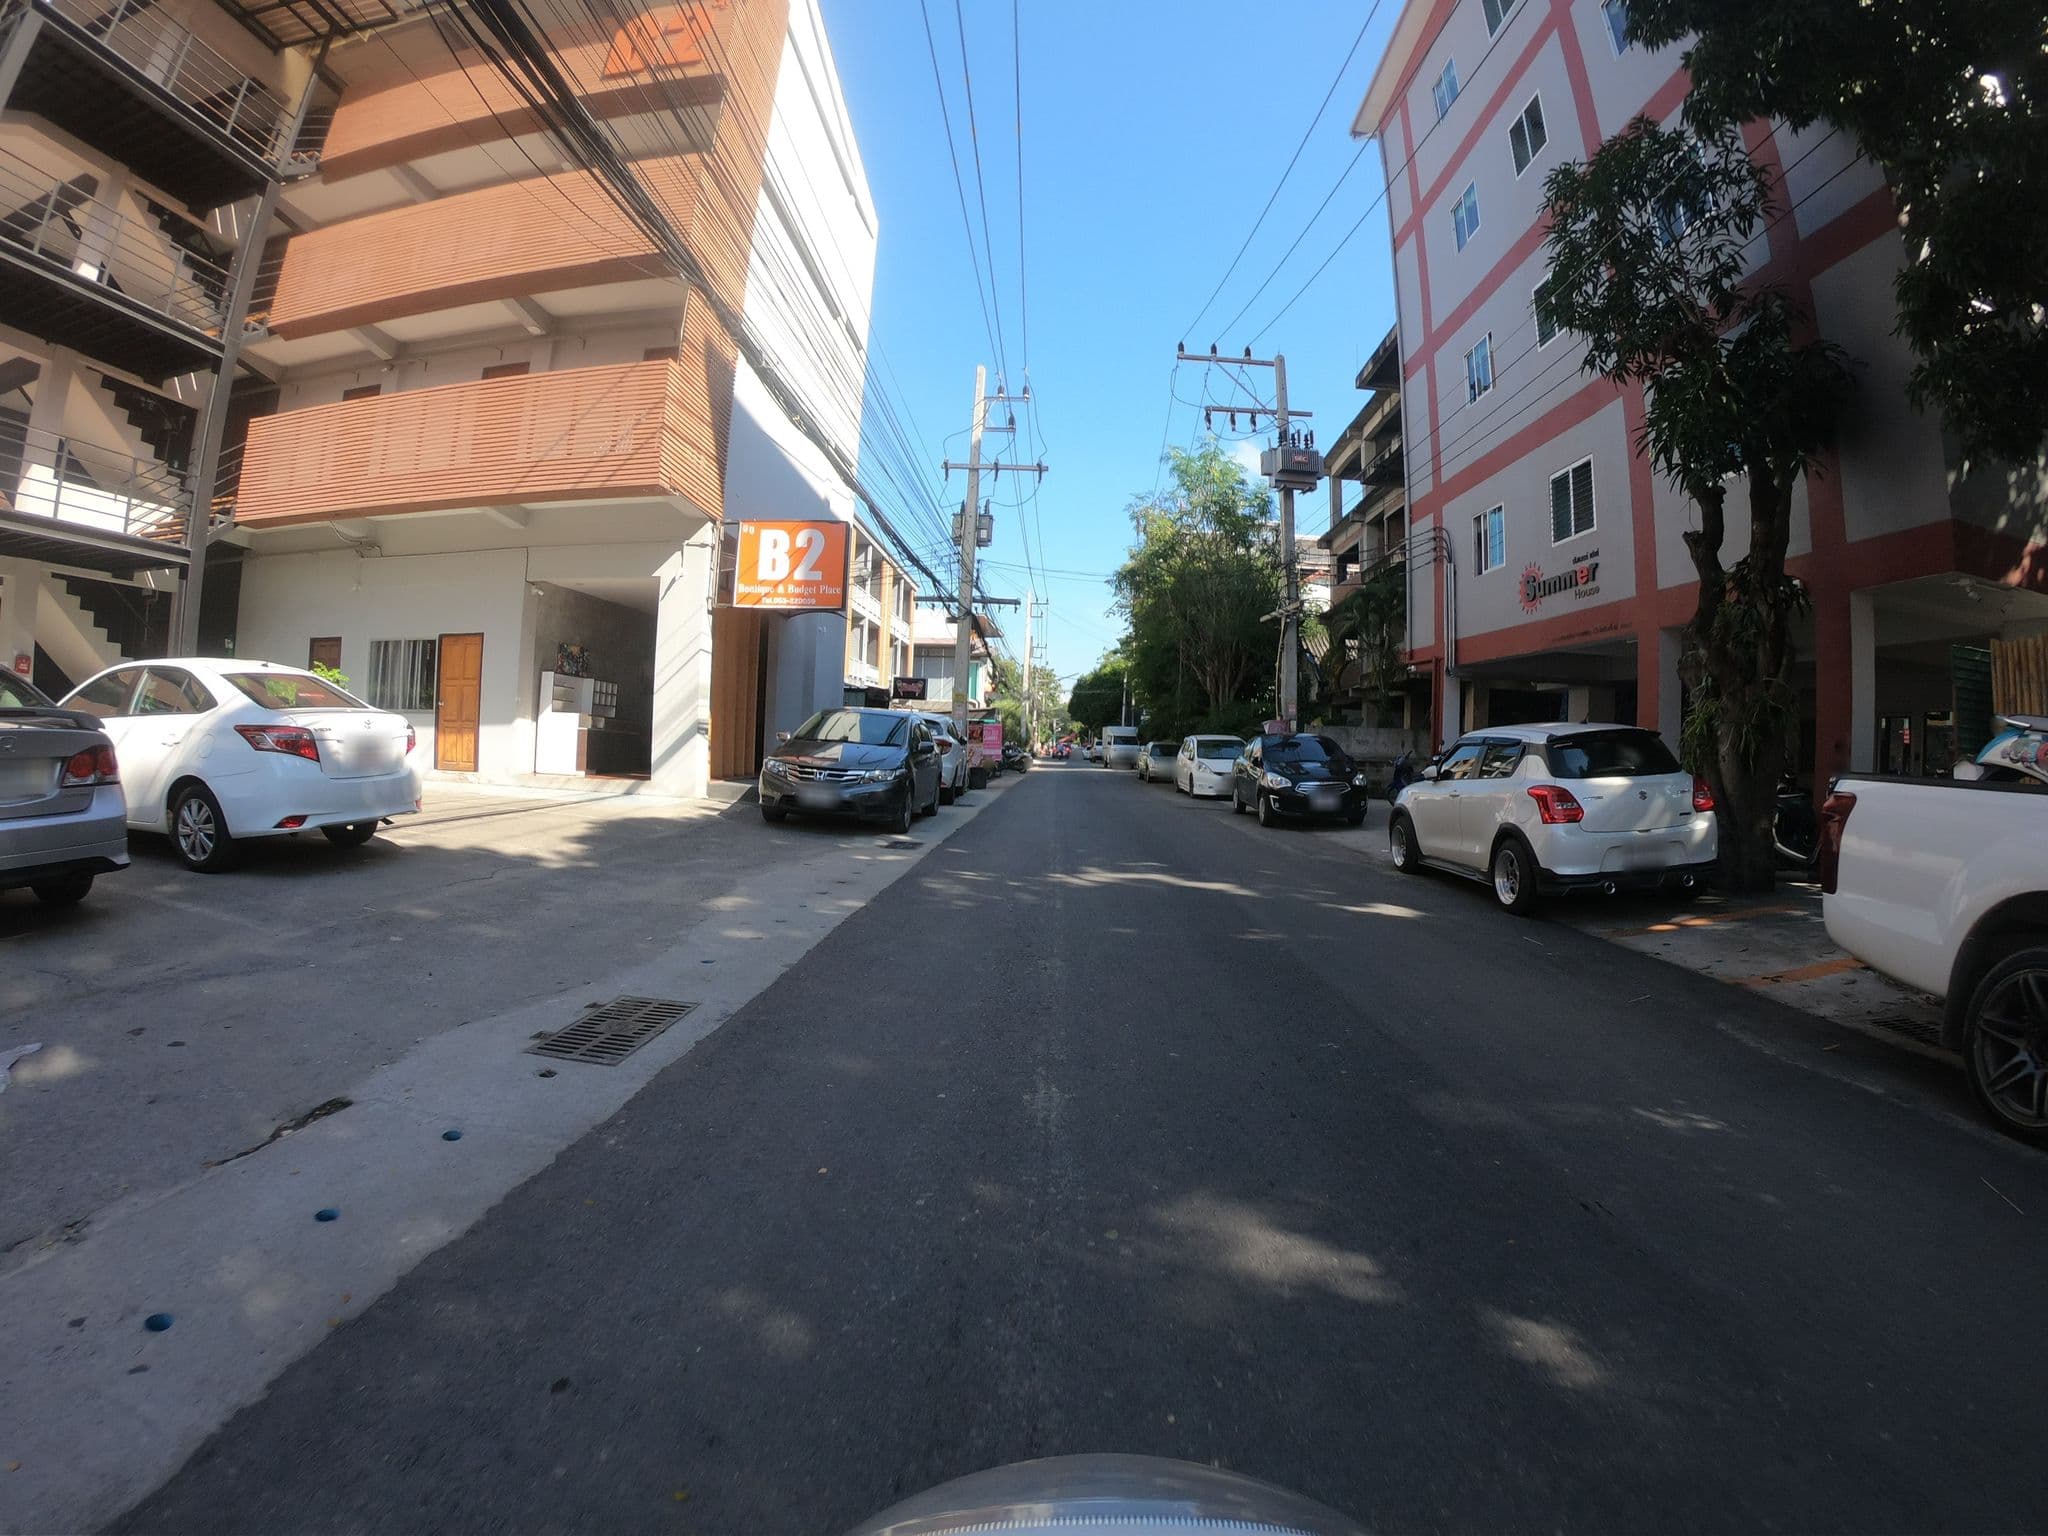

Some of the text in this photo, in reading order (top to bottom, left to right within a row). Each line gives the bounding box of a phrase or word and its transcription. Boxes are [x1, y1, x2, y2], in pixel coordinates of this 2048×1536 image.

[758, 529, 825, 581] B2
[788, 584, 817, 596] Budget
[819, 584, 841, 594] Place
[1525, 563, 1599, 602] Summer
[1575, 587, 1600, 600] House
